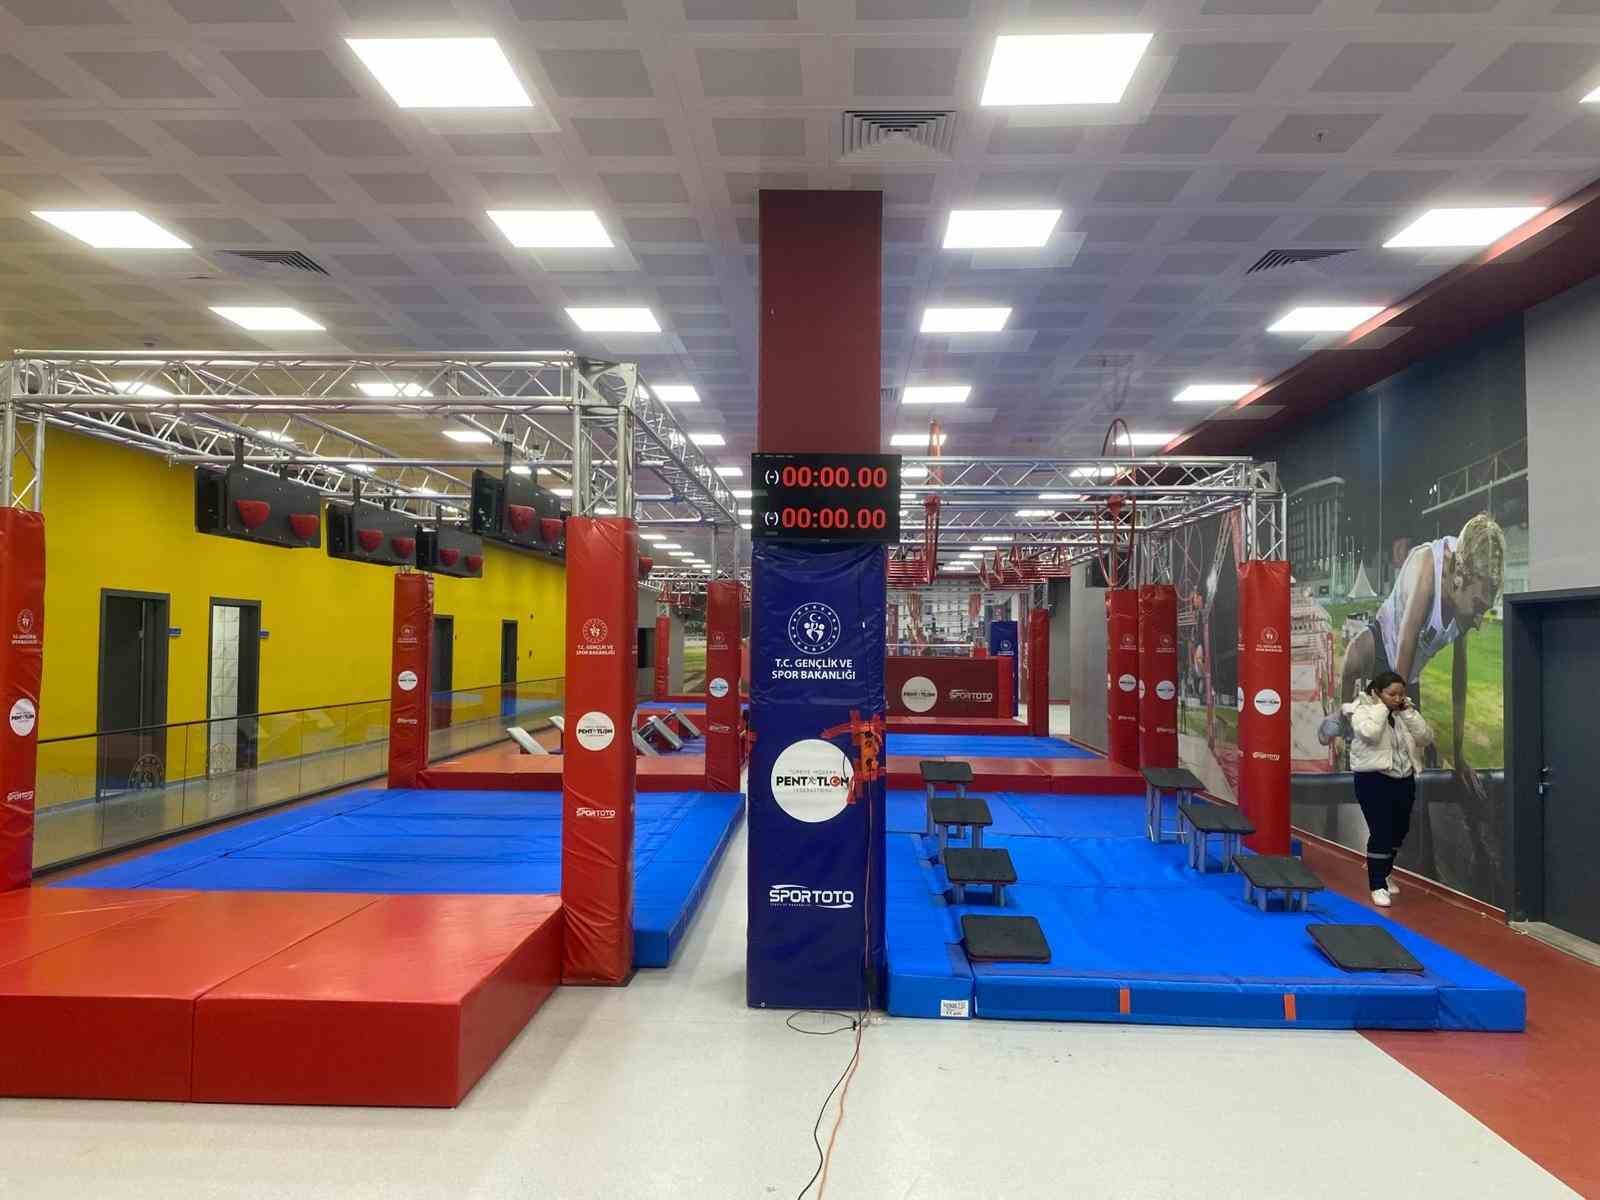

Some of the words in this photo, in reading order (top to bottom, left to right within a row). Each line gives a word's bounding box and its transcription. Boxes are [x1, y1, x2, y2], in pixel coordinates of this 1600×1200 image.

[782, 466, 888, 487] 00:00.00
[782, 508, 887, 529] 00:00.00
[775, 659, 793, 668] T.C.
[794, 657, 838, 669] GENÇLİK
[839, 659, 853, 668] VE
[771, 670, 799, 679] SPOR
[800, 669, 856, 680] BAKANLIĞI
[769, 889, 854, 903] SPORTOTO
